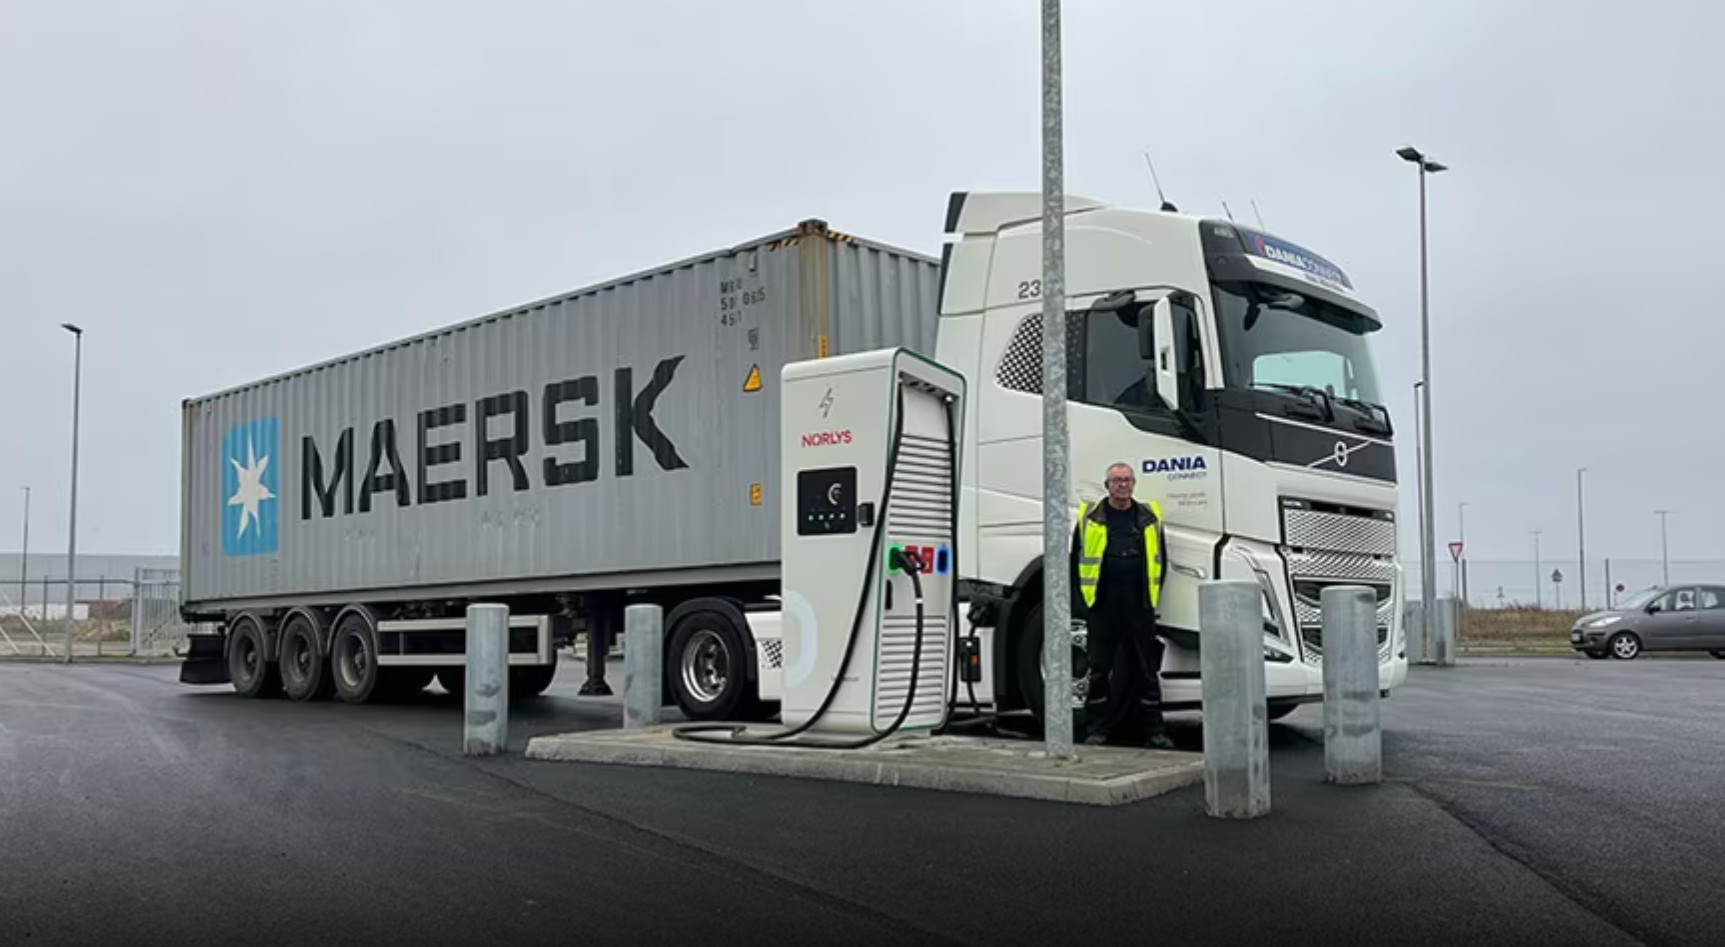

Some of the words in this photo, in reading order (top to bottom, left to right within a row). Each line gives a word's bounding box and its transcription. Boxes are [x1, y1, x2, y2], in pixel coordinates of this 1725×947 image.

[302, 355, 689, 520] MAERSK
[802, 430, 853, 447] NORLYS
[1142, 455, 1207, 474] DANIA
